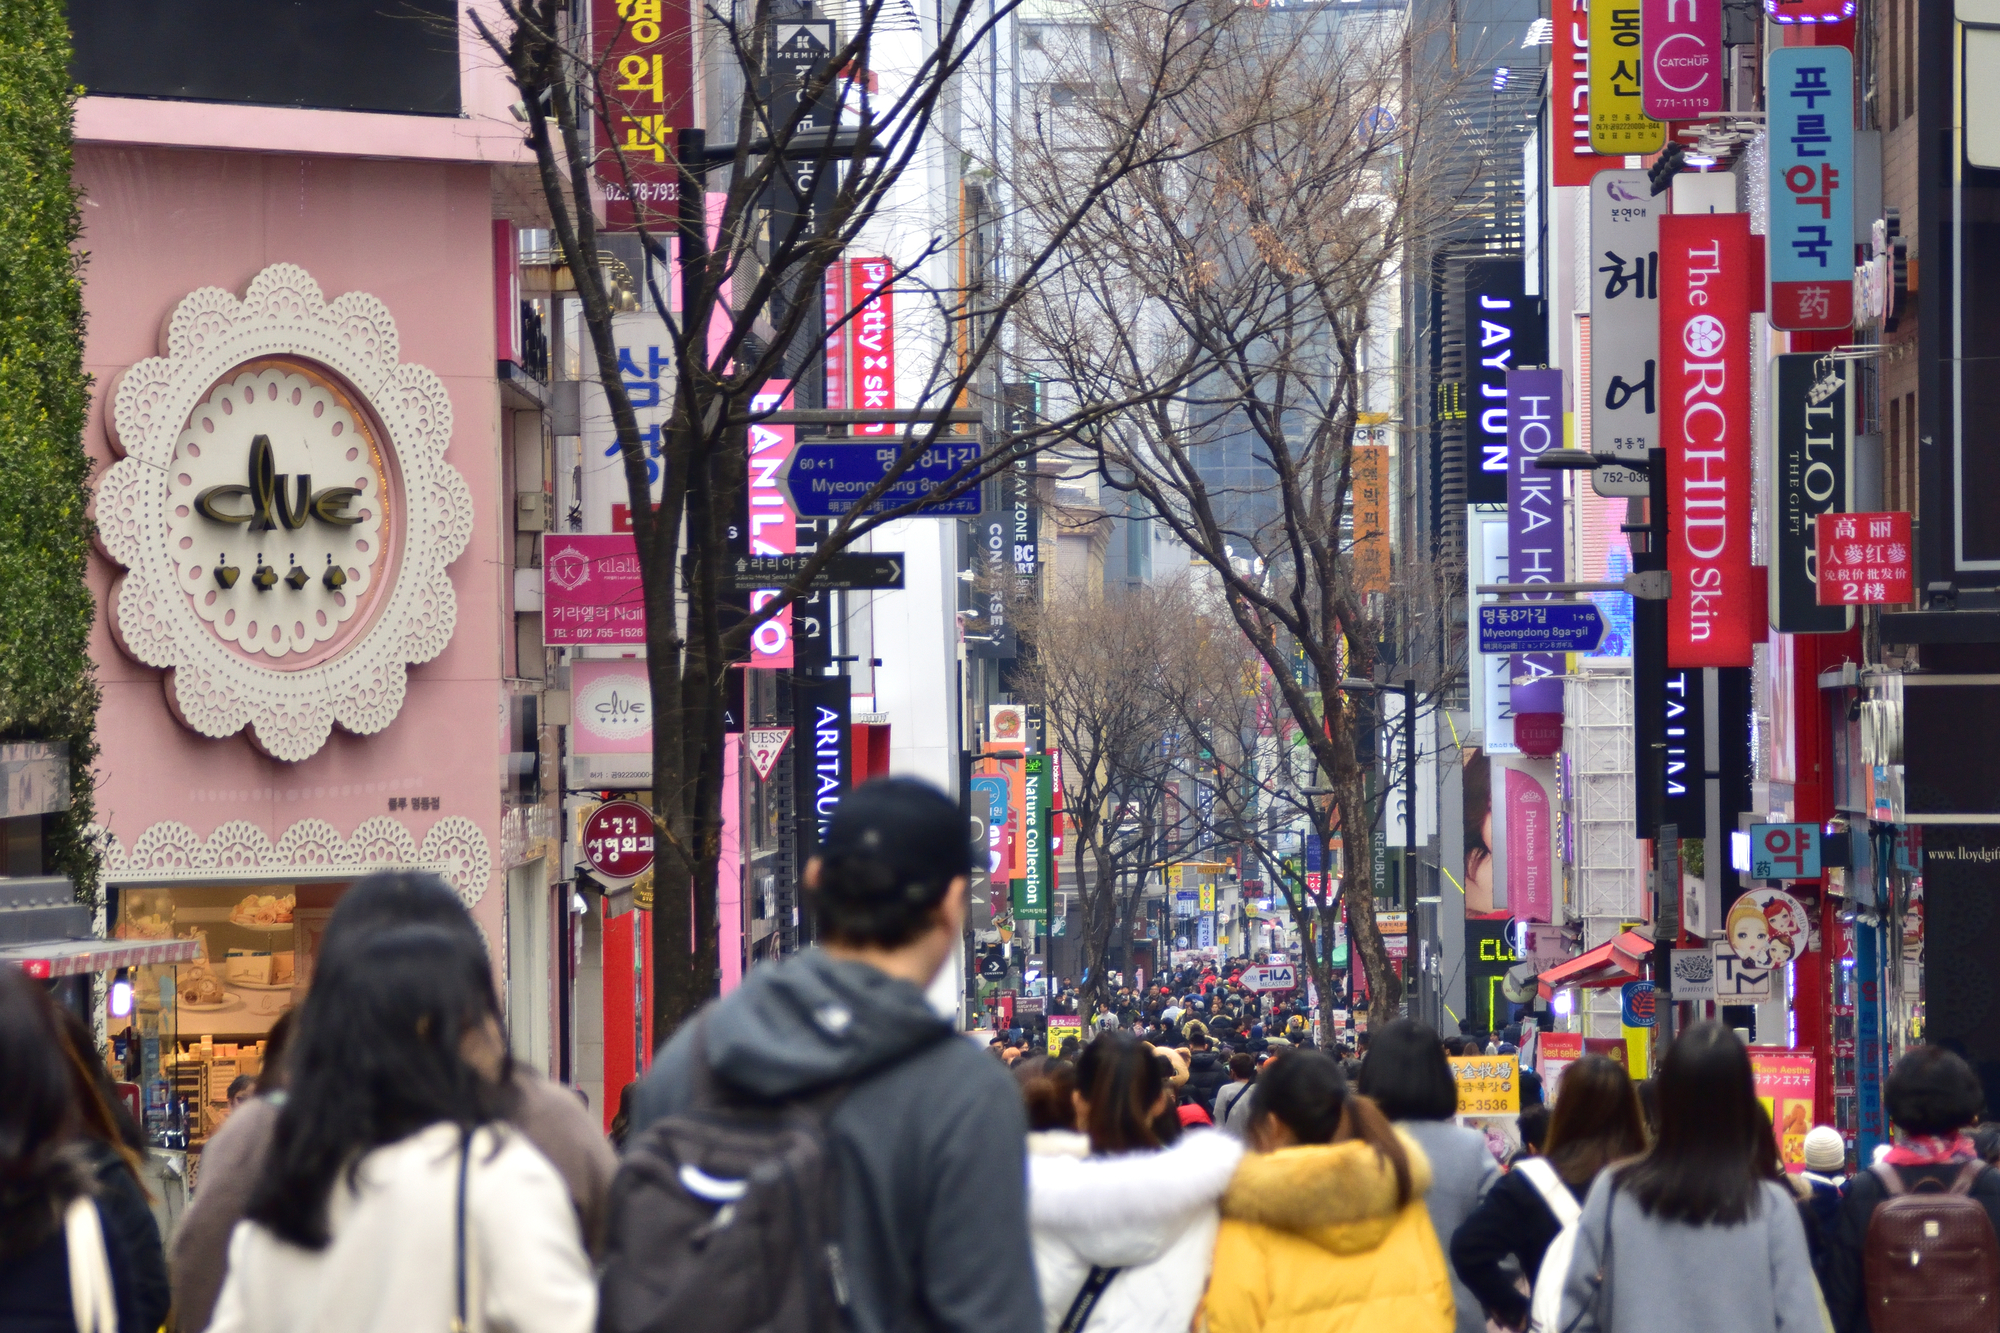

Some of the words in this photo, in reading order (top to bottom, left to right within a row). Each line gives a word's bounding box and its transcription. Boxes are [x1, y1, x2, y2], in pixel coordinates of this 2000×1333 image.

[1659, 57, 1709, 67] CATCHUP
[1655, 98, 1709, 108] 771-1119
[1785, 66, 1839, 268] 푸른약국
[606, 182, 680, 201] 02.78-793
[1610, 208, 1647, 222] 본연애
[1688, 239, 1720, 306] The
[858, 263, 886, 352] pretty
[1797, 285, 1830, 321] 药
[1598, 250, 1658, 415] 헤어
[864, 375, 889, 433] skn
[1356, 429, 1385, 441] CNP
[1614, 437, 1646, 450] 명동점
[1683, 314, 1726, 559] ORCHID
[800, 458, 814, 470] 60
[828, 458, 834, 469] 1
[876, 448, 976, 472] 명8나길
[1519, 396, 1552, 534] HOLIKA
[1789, 450, 1800, 488] THE
[1014, 460, 1028, 498] PLAY
[1602, 471, 1650, 484] 752-036
[1015, 501, 1028, 542] ZONE
[1789, 492, 1800, 536] GIFT
[1834, 515, 1893, 539] 高丽
[1014, 544, 1035, 562] BC
[735, 556, 820, 572] 솔라리아호
[1842, 582, 1886, 601] 2楼
[552, 606, 610, 622] 키라엘라
[614, 607, 643, 621] Nail
[1690, 568, 1722, 643] Skin
[1482, 608, 1547, 625] 명동8가길
[1521, 548, 1553, 686] HOA
[1572, 613, 1577, 621] 1
[1585, 613, 1596, 621] 66
[596, 628, 644, 638] 755-1526
[1482, 628, 1550, 639] Myeongdong
[1552, 626, 1588, 638] 8ga-gil
[595, 690, 646, 715] clue
[749, 732, 784, 744] UESS
[1521, 728, 1559, 740] ETUDE
[590, 771, 603, 780] 허가
[611, 771, 653, 779] 공92220000-
[1026, 776, 1039, 826] Nature
[600, 816, 637, 834] 노정식
[1525, 810, 1537, 862] Princess
[1374, 832, 1385, 889] REPUBLIC
[1764, 827, 1811, 876] 약
[1928, 850, 1956, 860] www.
[1026, 830, 1039, 904] Collection
[1755, 860, 1771, 877] 药
[1526, 866, 1538, 903] House
[1243, 975, 1257, 983] 30M
[1259, 969, 1292, 982] FILA
[1678, 985, 1714, 994] innisfre
[1543, 1047, 1559, 1058] Best
[1752, 1063, 1777, 1074] Raon
[1780, 1066, 1811, 1074] Aesthe
[1456, 1081, 1498, 1093] 금목장
[1501, 1083, 1512, 1091] 3F
[1753, 1075, 1811, 1086] ラオンエステ
[1457, 1099, 1508, 1111] 3-3536
